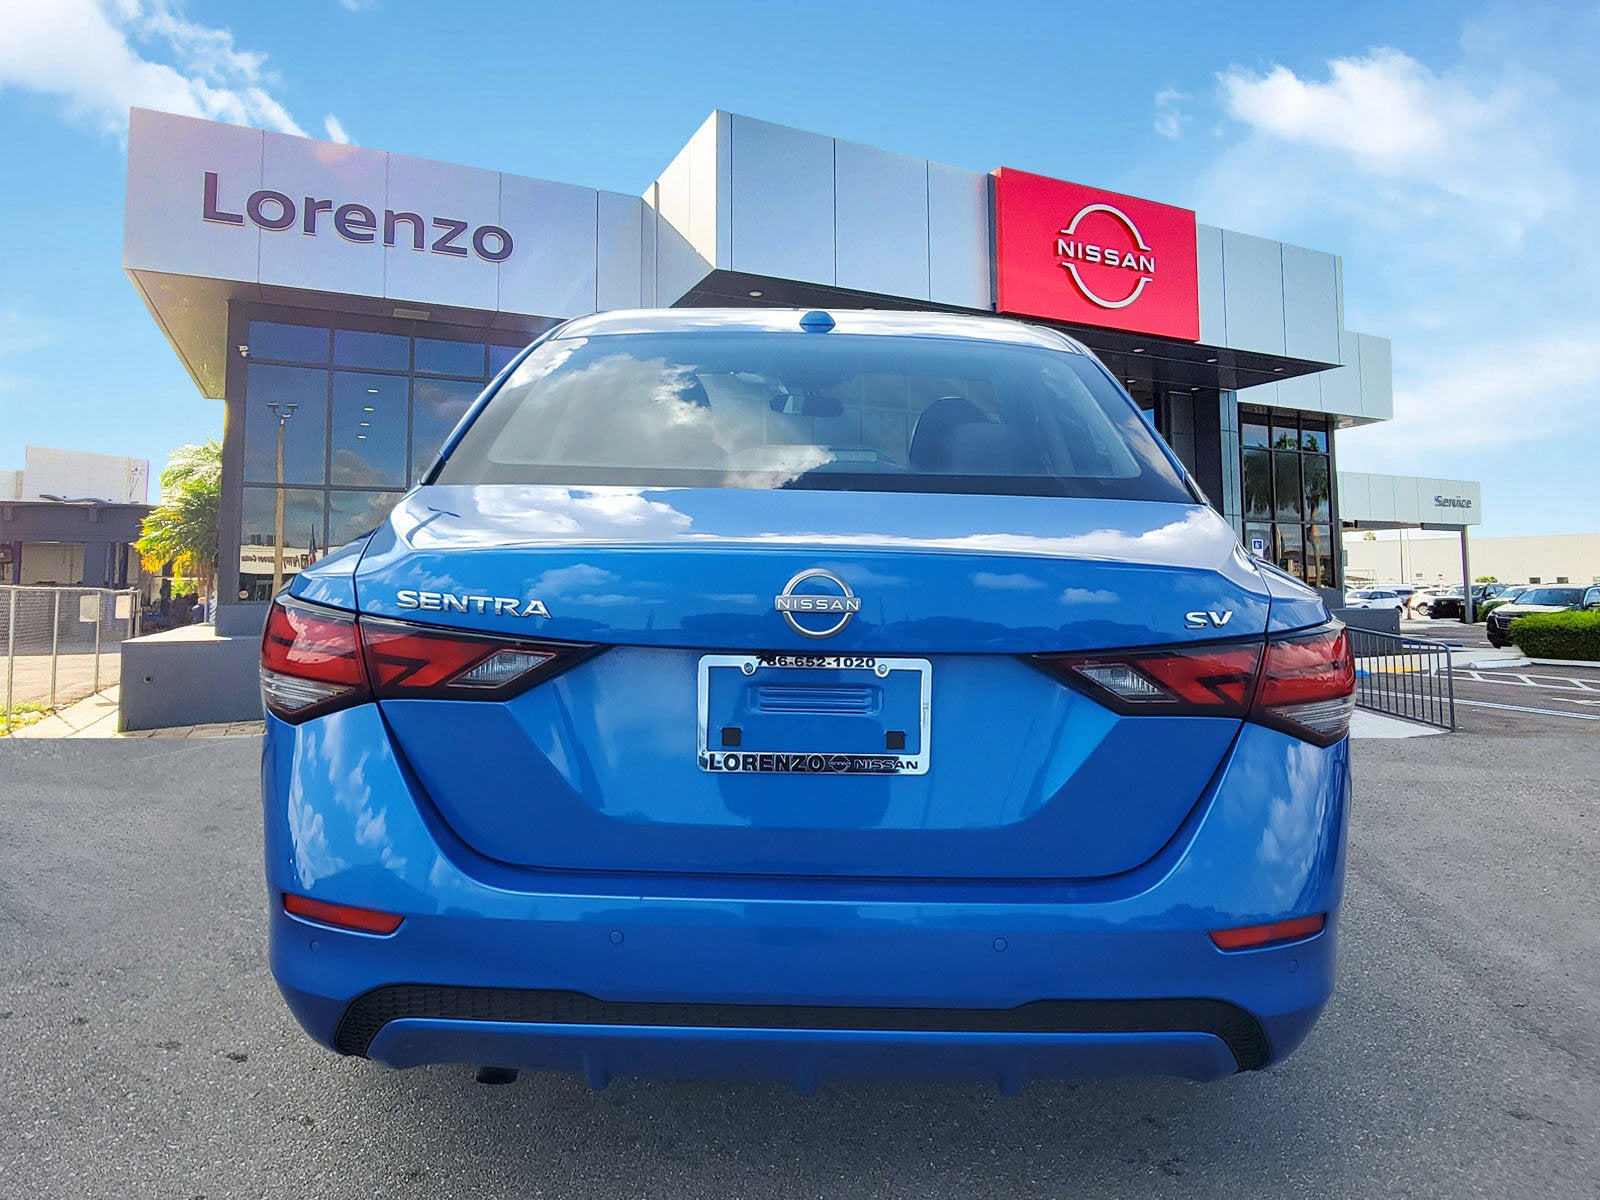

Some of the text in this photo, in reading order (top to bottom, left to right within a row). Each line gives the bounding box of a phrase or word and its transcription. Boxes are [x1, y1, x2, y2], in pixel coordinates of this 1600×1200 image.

[202, 171, 514, 262] Lorenzo
[1057, 238, 1155, 273] NISSAN
[1434, 495, 1472, 508] Service
[396, 590, 552, 619] SENTRA
[777, 599, 859, 611] NISSAN
[1184, 611, 1233, 629] SV
[709, 753, 919, 772] LORENZO NISSAN
